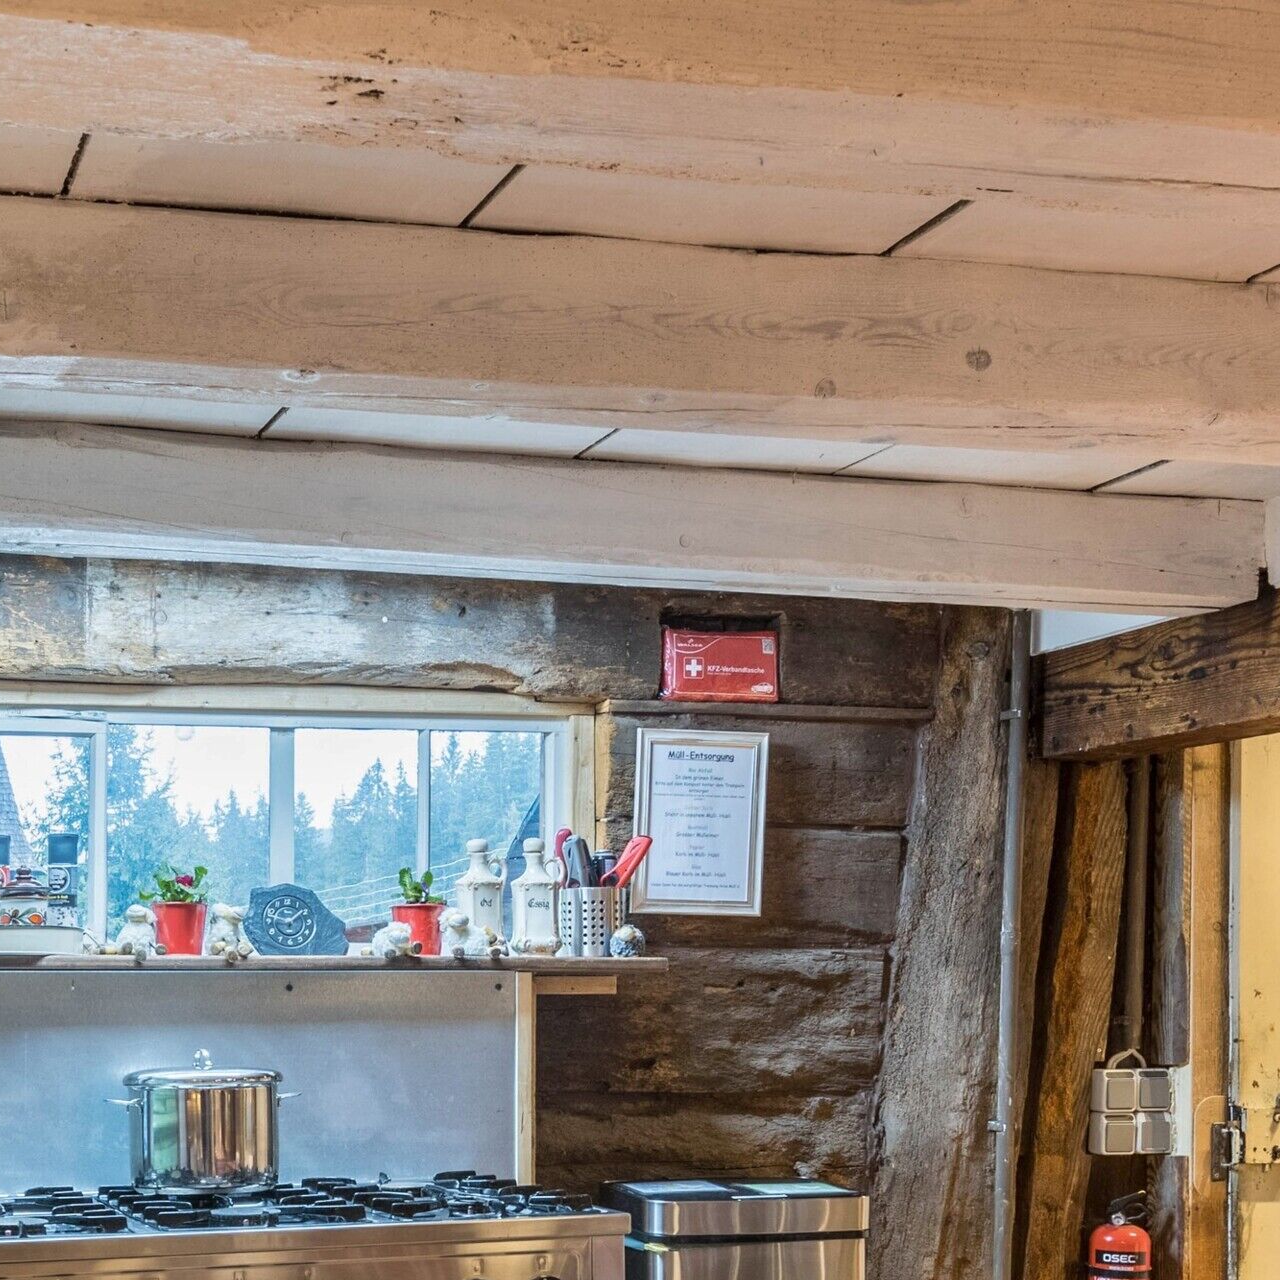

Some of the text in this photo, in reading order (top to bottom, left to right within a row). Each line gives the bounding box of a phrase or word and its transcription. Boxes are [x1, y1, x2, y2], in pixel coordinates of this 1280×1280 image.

[707, 665, 765, 674] KFZ-Verbandtasche
[527, 898, 550, 911] Essig
[1102, 1253, 1136, 1264] OSEC
